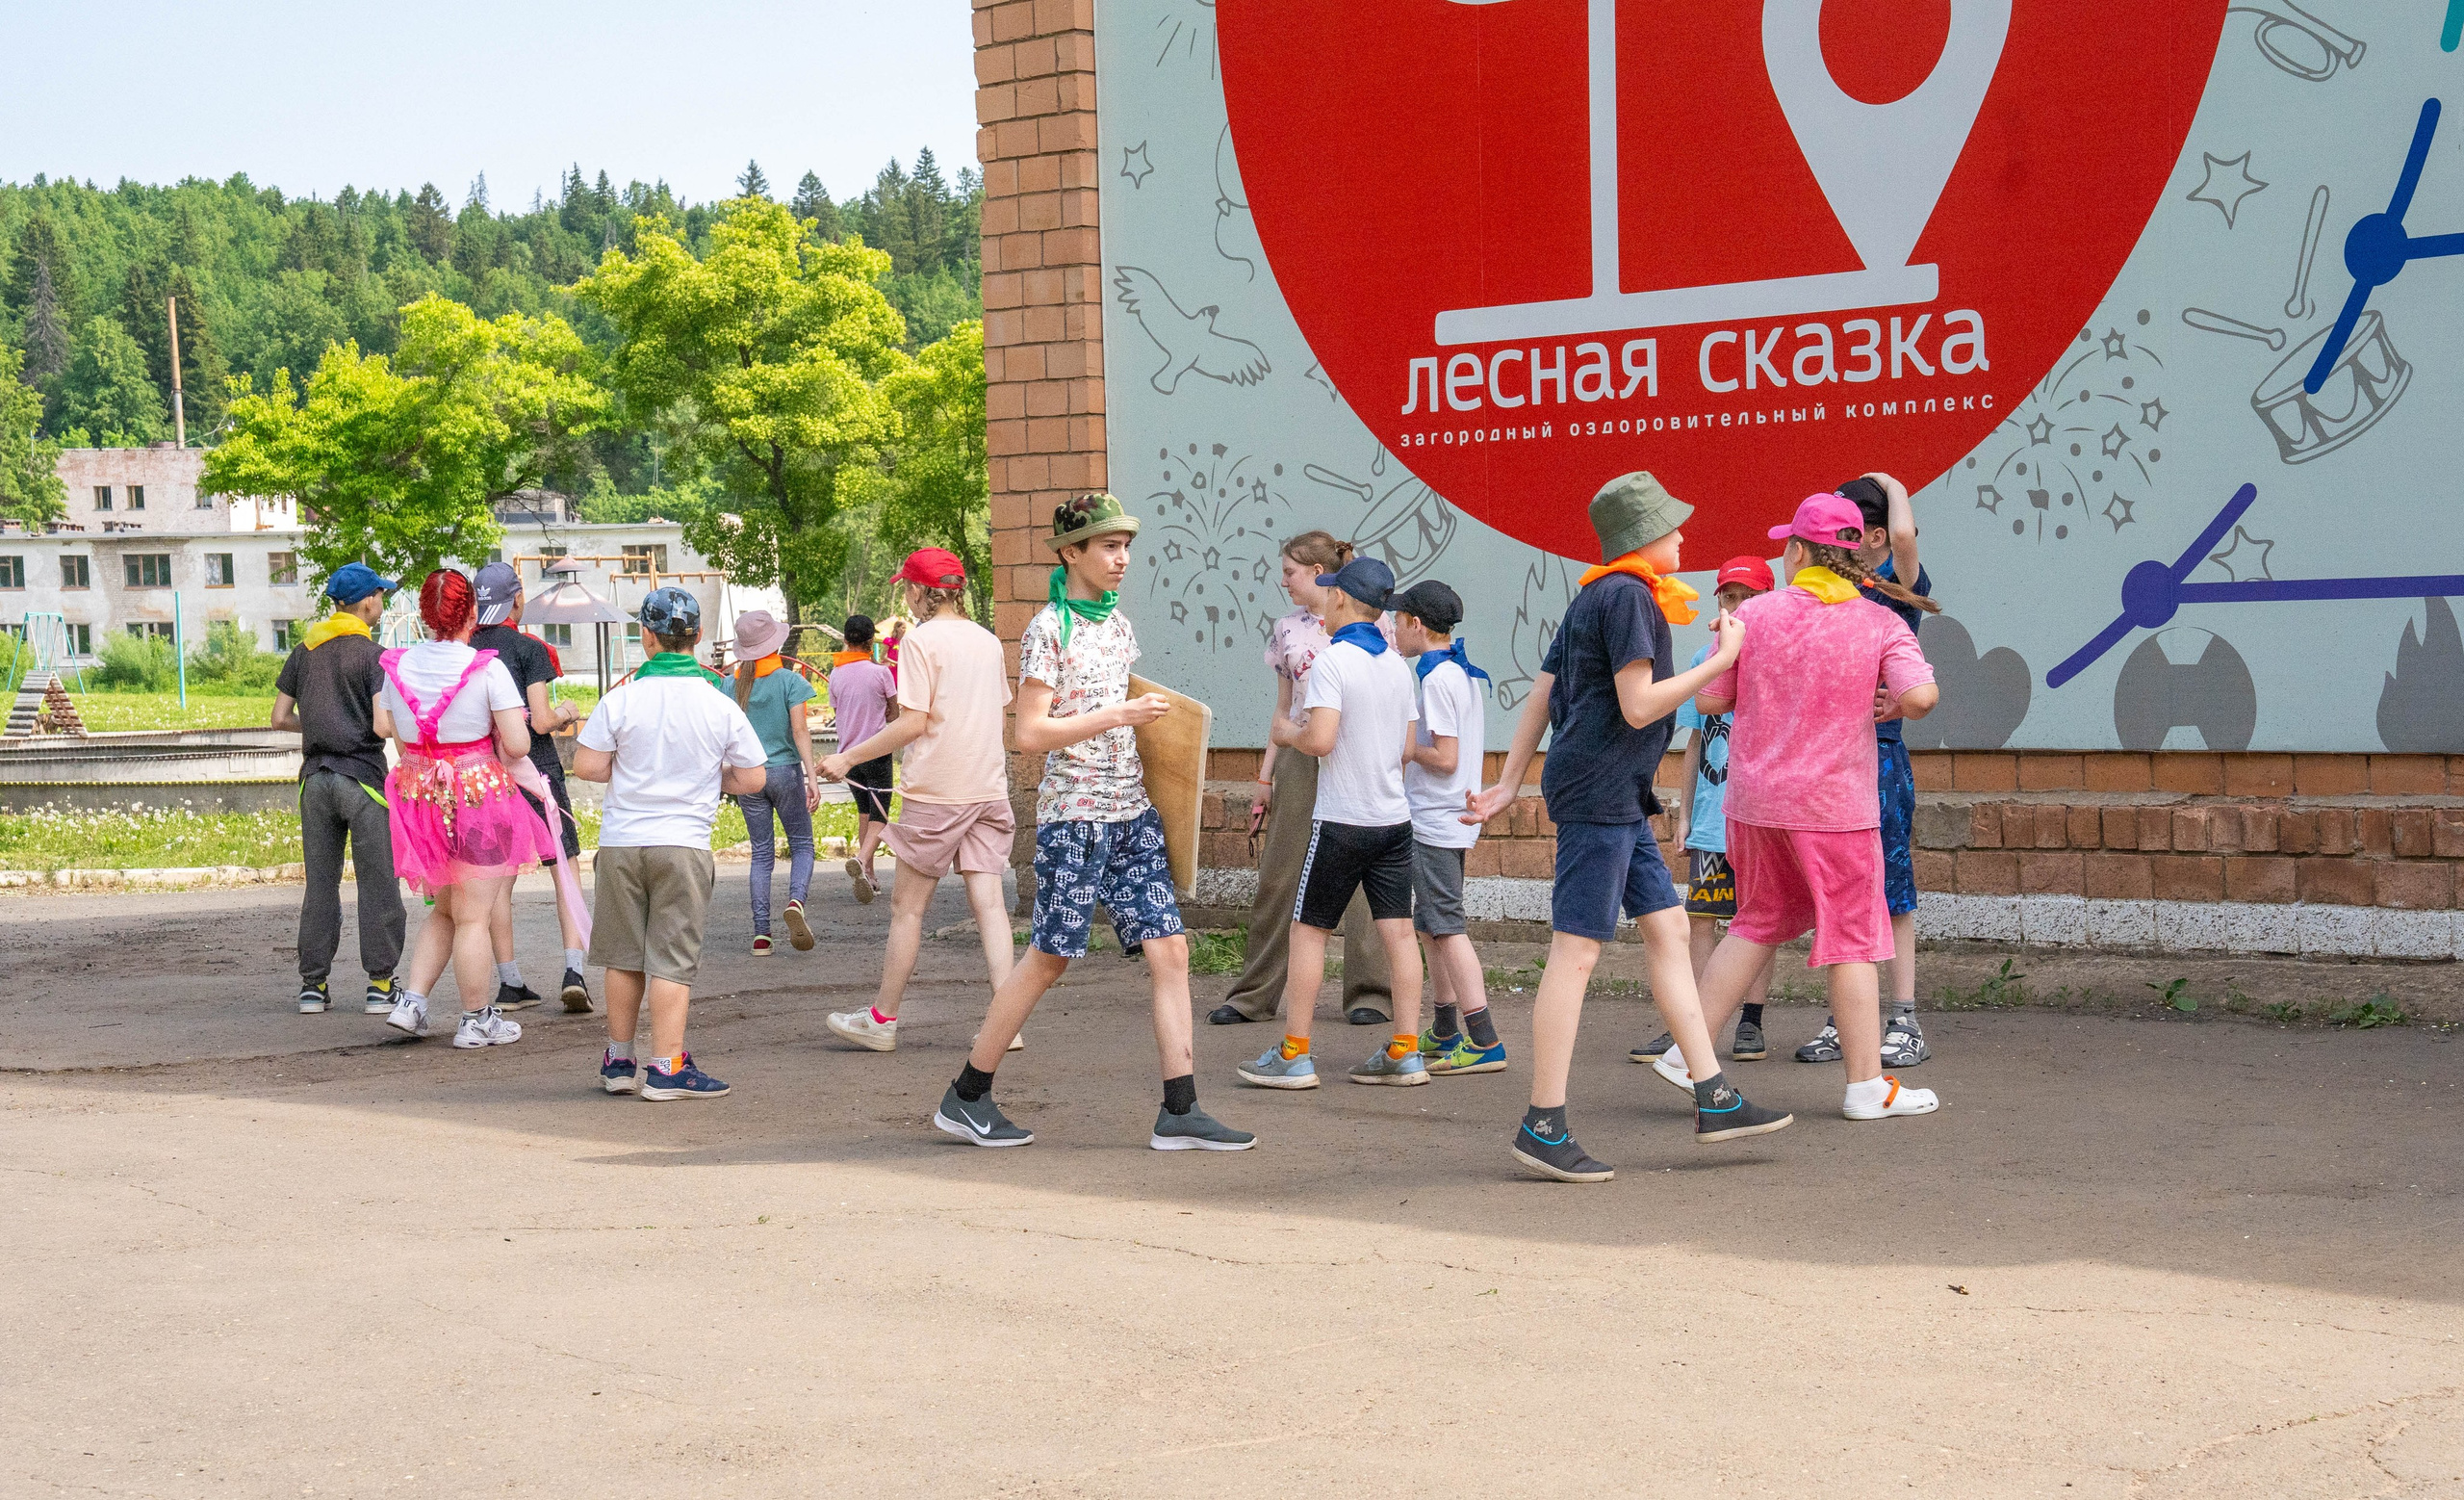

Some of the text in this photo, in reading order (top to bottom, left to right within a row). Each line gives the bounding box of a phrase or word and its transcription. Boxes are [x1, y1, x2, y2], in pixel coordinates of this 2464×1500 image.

[1400, 308, 1990, 415] лесная сказка
[1400, 394, 1993, 448] загородный оздоровительный комплекс
